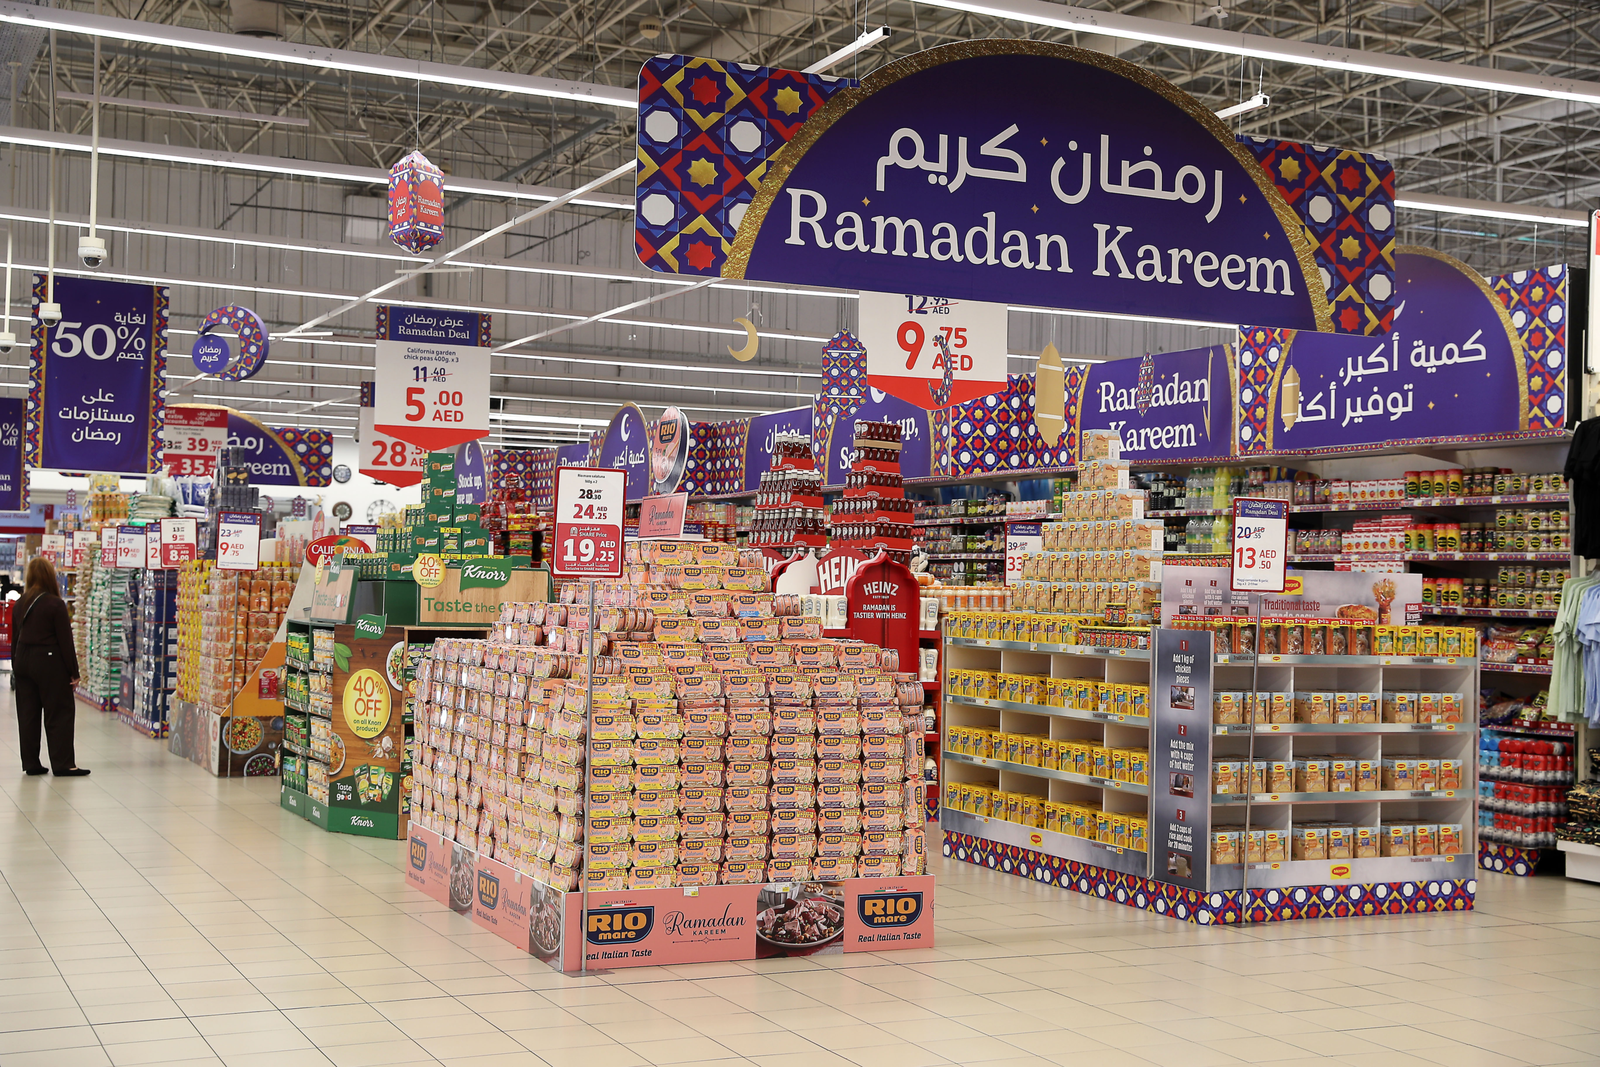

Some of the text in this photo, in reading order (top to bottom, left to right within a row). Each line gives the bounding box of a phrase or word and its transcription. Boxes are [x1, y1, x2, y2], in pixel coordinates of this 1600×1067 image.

[876, 123, 1222, 223] رمضان كريم
[418, 195, 441, 208] Ramadan
[420, 205, 439, 217] Kareem
[785, 187, 1295, 296] Ramadan Kareem
[905, 294, 928, 315] 12
[114, 312, 146, 325] لغاية
[405, 314, 464, 328] عرض رمضان
[398, 325, 470, 339] Ramadan Deal
[51, 321, 146, 360] 50%
[897, 321, 925, 370] 9
[198, 345, 221, 355] رمضان
[407, 347, 435, 355] California
[1410, 329, 1487, 373] كمية
[116, 352, 144, 362] خصم
[200, 354, 219, 363] كريم
[413, 366, 427, 382] 11
[81, 388, 114, 404] على
[405, 387, 463, 422] 5 .00
[1341, 383, 1414, 427] توفير
[58, 406, 135, 424] مستلزمات
[432, 410, 464, 422] AED
[71, 426, 121, 445] رمضان
[661, 423, 676, 435] RIO
[2, 437, 18, 446] off
[1109, 421, 1197, 453] Kareem
[187, 438, 208, 451] 39
[371, 440, 407, 467] 28
[629, 448, 645, 467] كمية
[181, 459, 205, 474] 35
[246, 463, 292, 476] reem
[458, 473, 473, 488] Stock
[579, 489, 593, 499] 28
[573, 504, 595, 519] 24
[649, 499, 674, 525] Ramadan
[221, 529, 231, 537] 23
[1237, 526, 1251, 539] 20
[119, 547, 130, 557] 19
[220, 542, 229, 555] 9
[563, 539, 595, 562] 19
[1008, 542, 1018, 550] 39
[169, 550, 178, 561] 8
[419, 556, 442, 568] 40%
[596, 551, 615, 562] .25
[1236, 547, 1276, 568] 13 AED
[1259, 561, 1271, 569] .50
[420, 568, 441, 578] OFF
[463, 565, 508, 581] Knorr
[818, 556, 860, 595] HEIN
[863, 581, 899, 596] HEINZ
[424, 598, 495, 613] Taste the
[1264, 599, 1320, 611] Traditional taste
[356, 619, 382, 635] Knorr
[1175, 664, 1191, 673] chicken
[1176, 674, 1189, 683] pieces
[353, 675, 383, 697] 40%
[354, 698, 382, 717] OFF
[356, 725, 378, 733] products
[1170, 739, 1178, 748] Add
[1186, 742, 1194, 751] mix
[1170, 750, 1193, 761] with cups
[1182, 762, 1194, 771] water
[336, 782, 352, 791] Taste
[350, 816, 374, 828] Knorr
[1184, 835, 1192, 843] cook
[411, 842, 425, 861] RIO
[1178, 843, 1192, 852] minutes
[428, 851, 448, 875] Ramadan
[479, 876, 497, 899] RIO
[482, 894, 493, 905] mare
[501, 888, 527, 917] Ramadan
[864, 898, 917, 918] RIO
[588, 912, 647, 932] RIO
[662, 902, 746, 936] Ramadan
[873, 913, 907, 924] mare
[598, 930, 636, 940] mare
[858, 931, 922, 943] Real Italian Taste
[586, 949, 652, 960] eal Italian Taste
